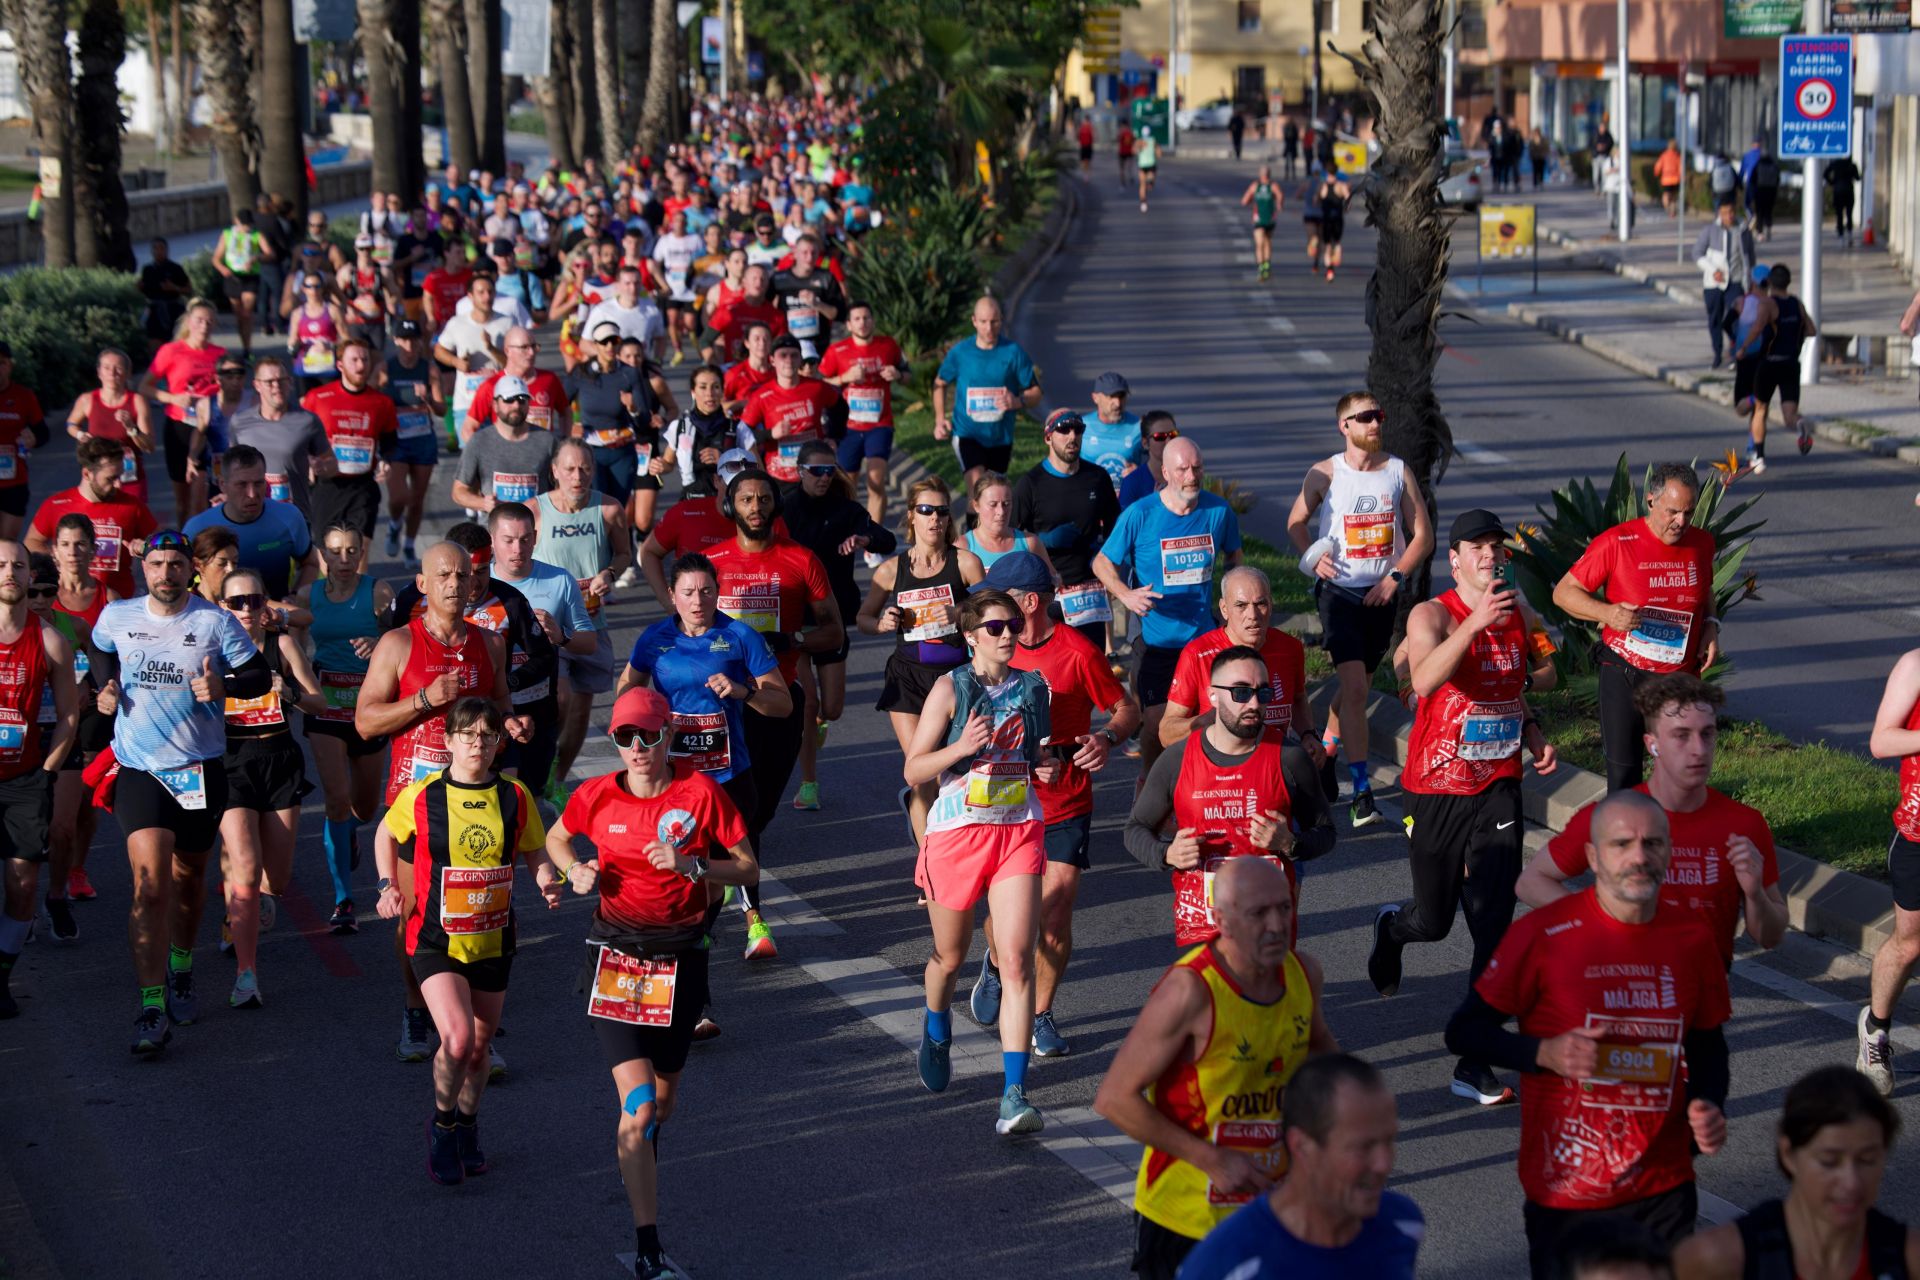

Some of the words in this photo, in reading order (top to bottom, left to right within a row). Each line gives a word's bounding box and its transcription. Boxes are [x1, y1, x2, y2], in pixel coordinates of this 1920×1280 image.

[1796, 54, 1836, 65] CARRIL
[1789, 65, 1843, 77] DERECHO
[1805, 91, 1828, 106] 30
[1783, 121, 1846, 132] PREFERENCIA
[552, 522, 597, 539] HOKA
[1175, 536, 1209, 549] GENERALI
[1173, 553, 1205, 565] 10120
[733, 572, 768, 580] GENERALI
[1649, 575, 1687, 588] MÁLAGA
[732, 584, 768, 596] MÁLAGA
[734, 600, 774, 608] GENERALI
[1643, 625, 1677, 640] 17693
[140, 670, 184, 685] DESTINO
[682, 735, 714, 746] 4218
[990, 764, 1026, 775] GENERALI
[1203, 789, 1243, 798] GENERALI
[1204, 804, 1244, 820] MÁLAGA
[464, 869, 510, 882] GENERALI
[467, 892, 493, 905] 882
[1601, 964, 1656, 978] GENERALI
[1604, 988, 1659, 1009] MÁLAGA
[1612, 1023, 1676, 1039] GENERALI
[1609, 1050, 1654, 1068] 6904
